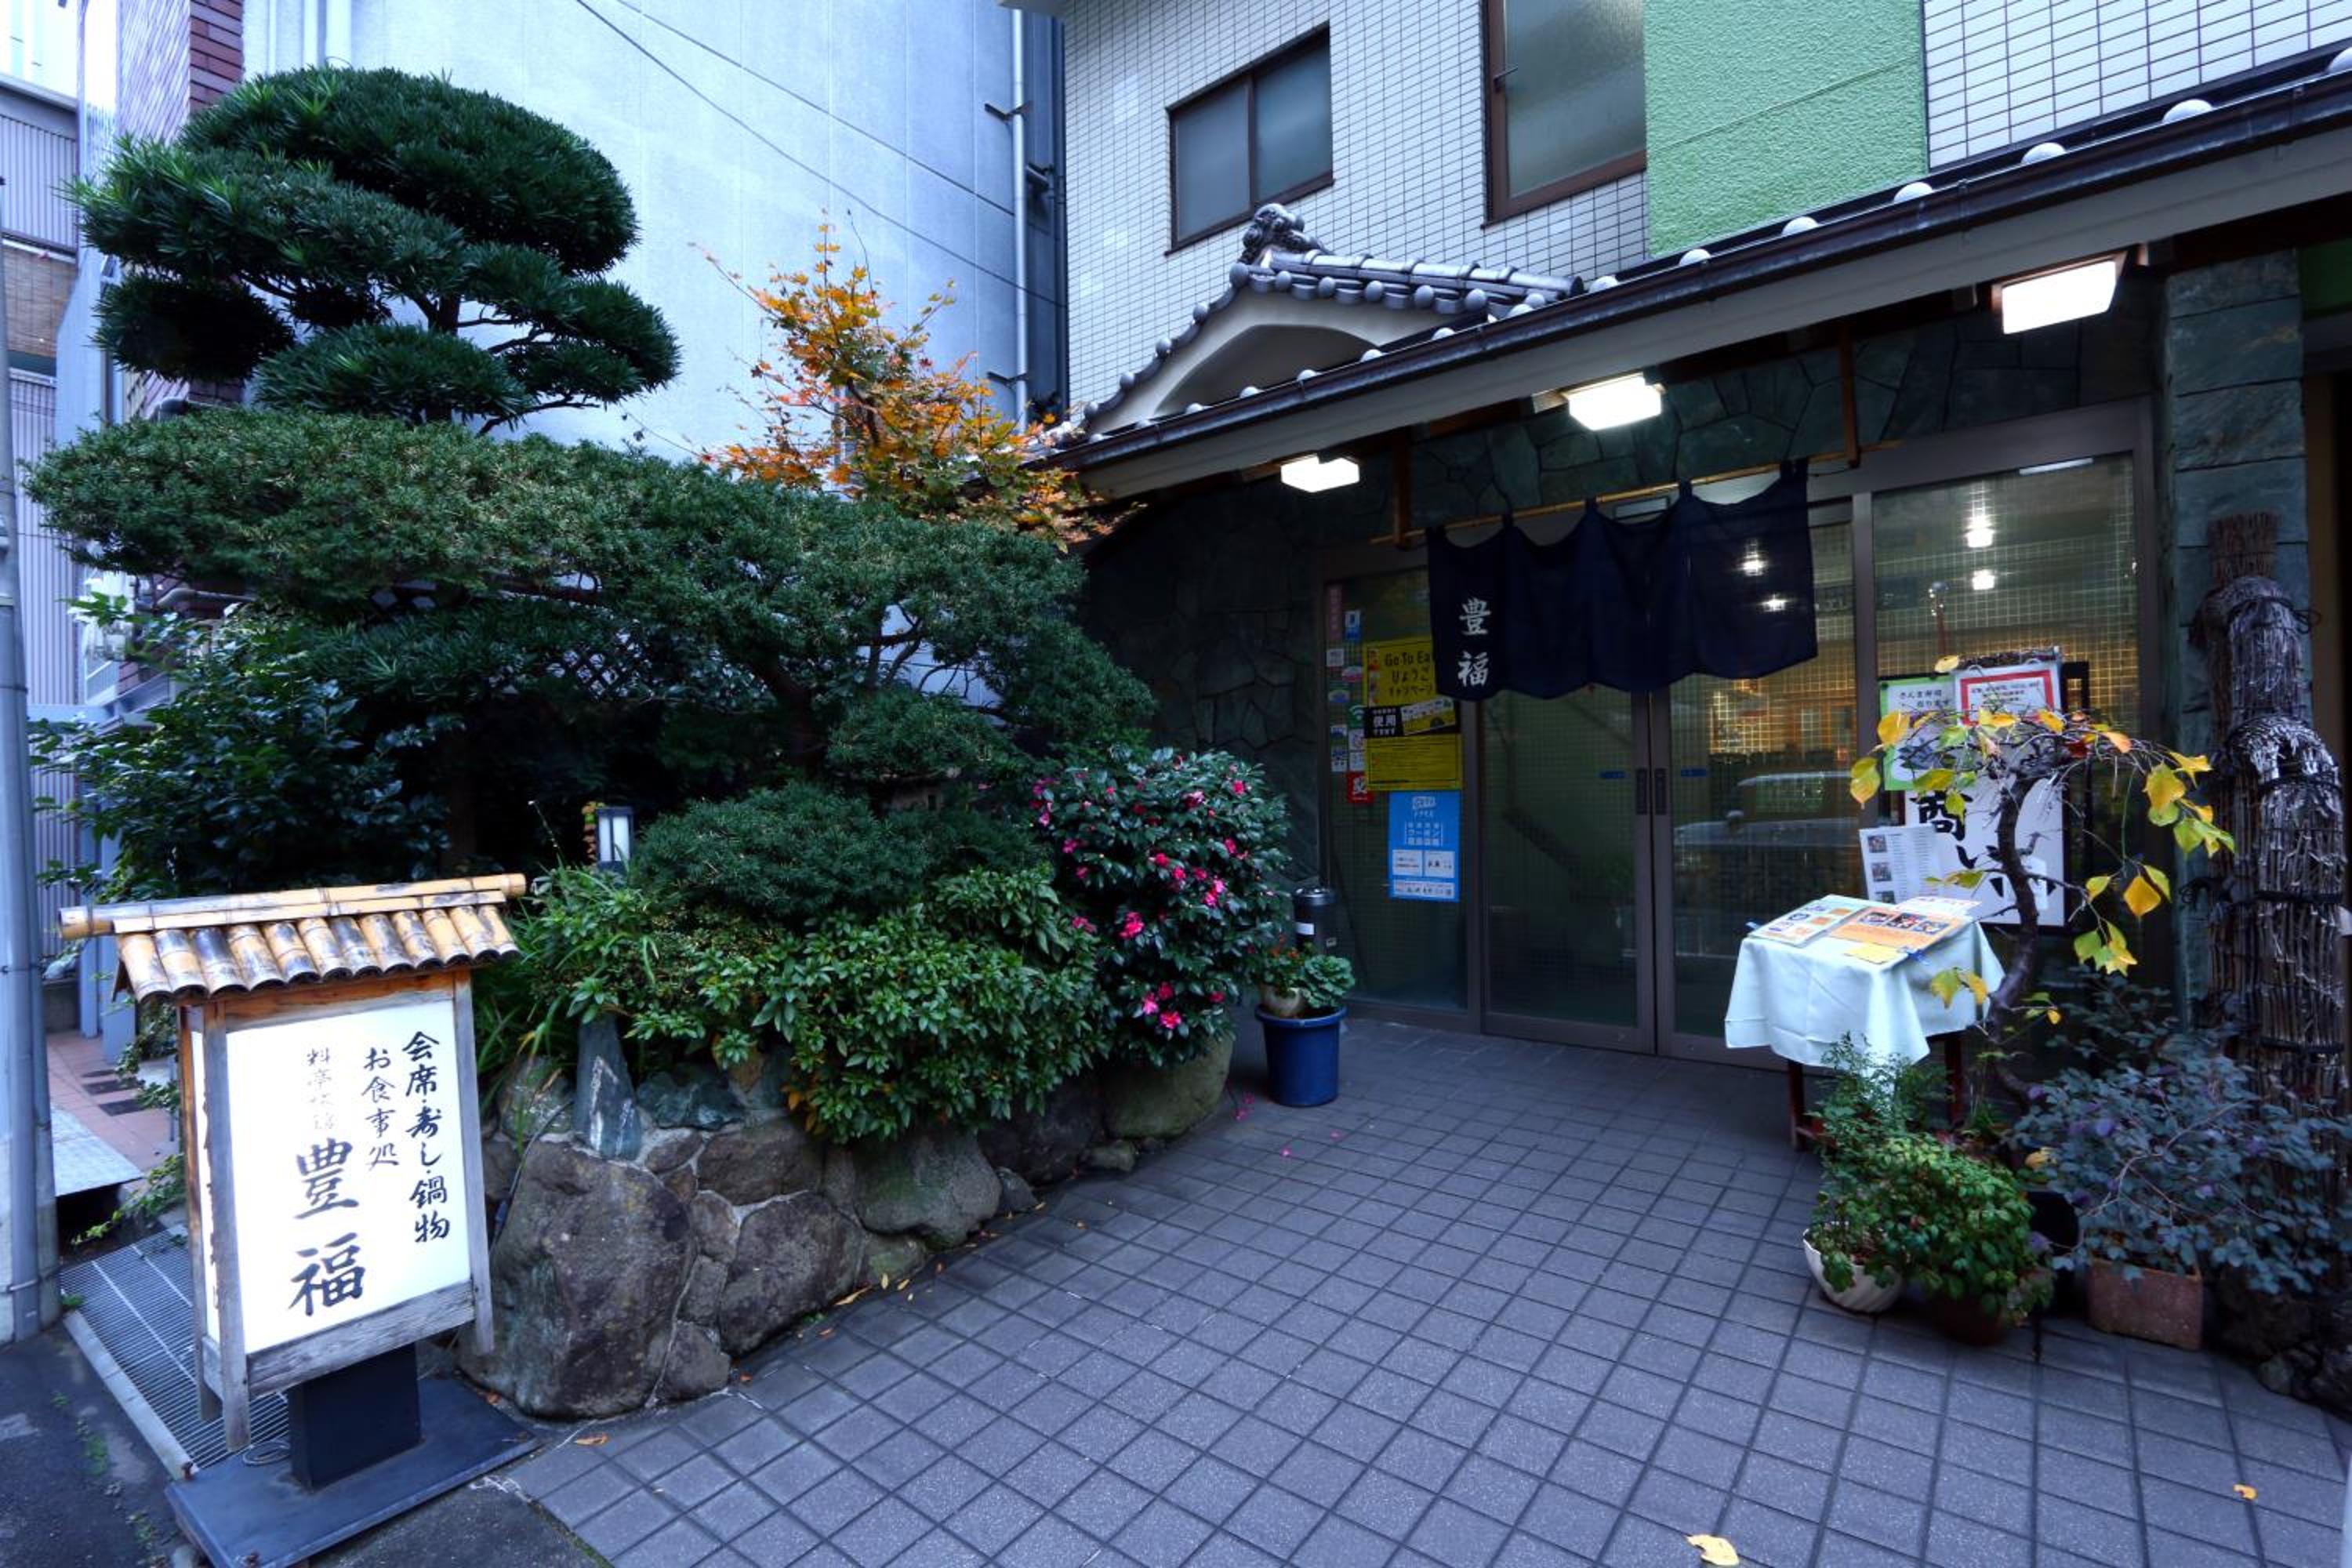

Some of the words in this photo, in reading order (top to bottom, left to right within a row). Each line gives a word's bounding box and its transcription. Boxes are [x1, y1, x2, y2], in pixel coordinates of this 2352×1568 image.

[1417, 648, 1432, 664] Ea
[1457, 597, 1492, 688] 豊福
[361, 1047, 399, 1171] お食事処
[289, 1138, 366, 1316] 豊福
